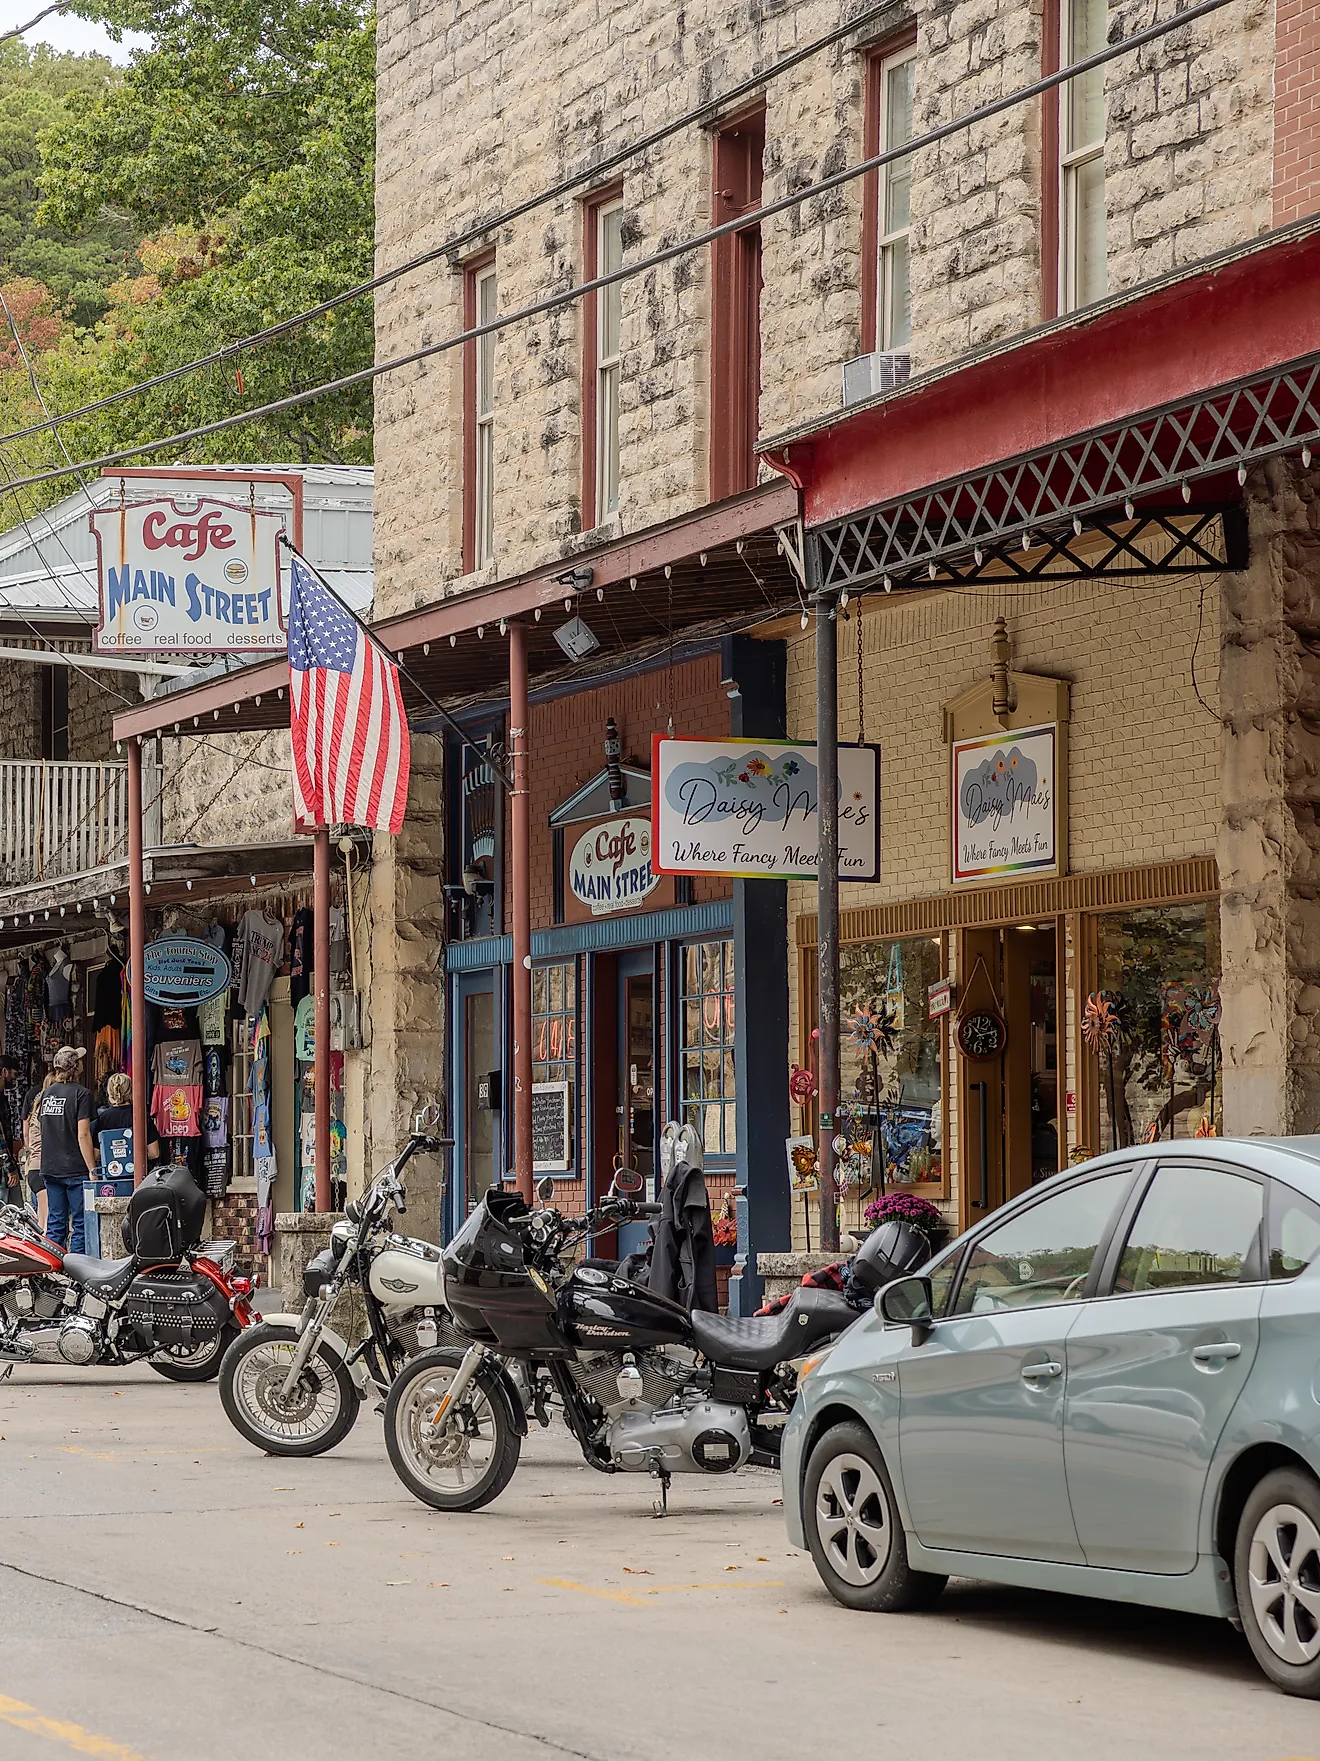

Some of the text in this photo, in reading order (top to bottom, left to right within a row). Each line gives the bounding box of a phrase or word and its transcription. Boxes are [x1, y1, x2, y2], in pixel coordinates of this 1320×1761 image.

[142, 511, 236, 560] Cafe
[108, 564, 272, 624] MAIN STREET
[101, 632, 283, 645] coffee real food desserts
[679, 778, 870, 836] Daisy Mes
[966, 777, 1051, 832] Daisy Maes
[596, 821, 636, 879] Cafe
[672, 840, 866, 870] Where Fancy Meet Fun
[963, 833, 1048, 864] Where Fancy Meets Fun
[573, 859, 658, 900] MAIN STREE
[145, 945, 218, 965] The Tourist Stop
[143, 972, 213, 986] Souveniers
[704, 986, 735, 1029] OPE
[166, 1122, 189, 1135] Jeep
